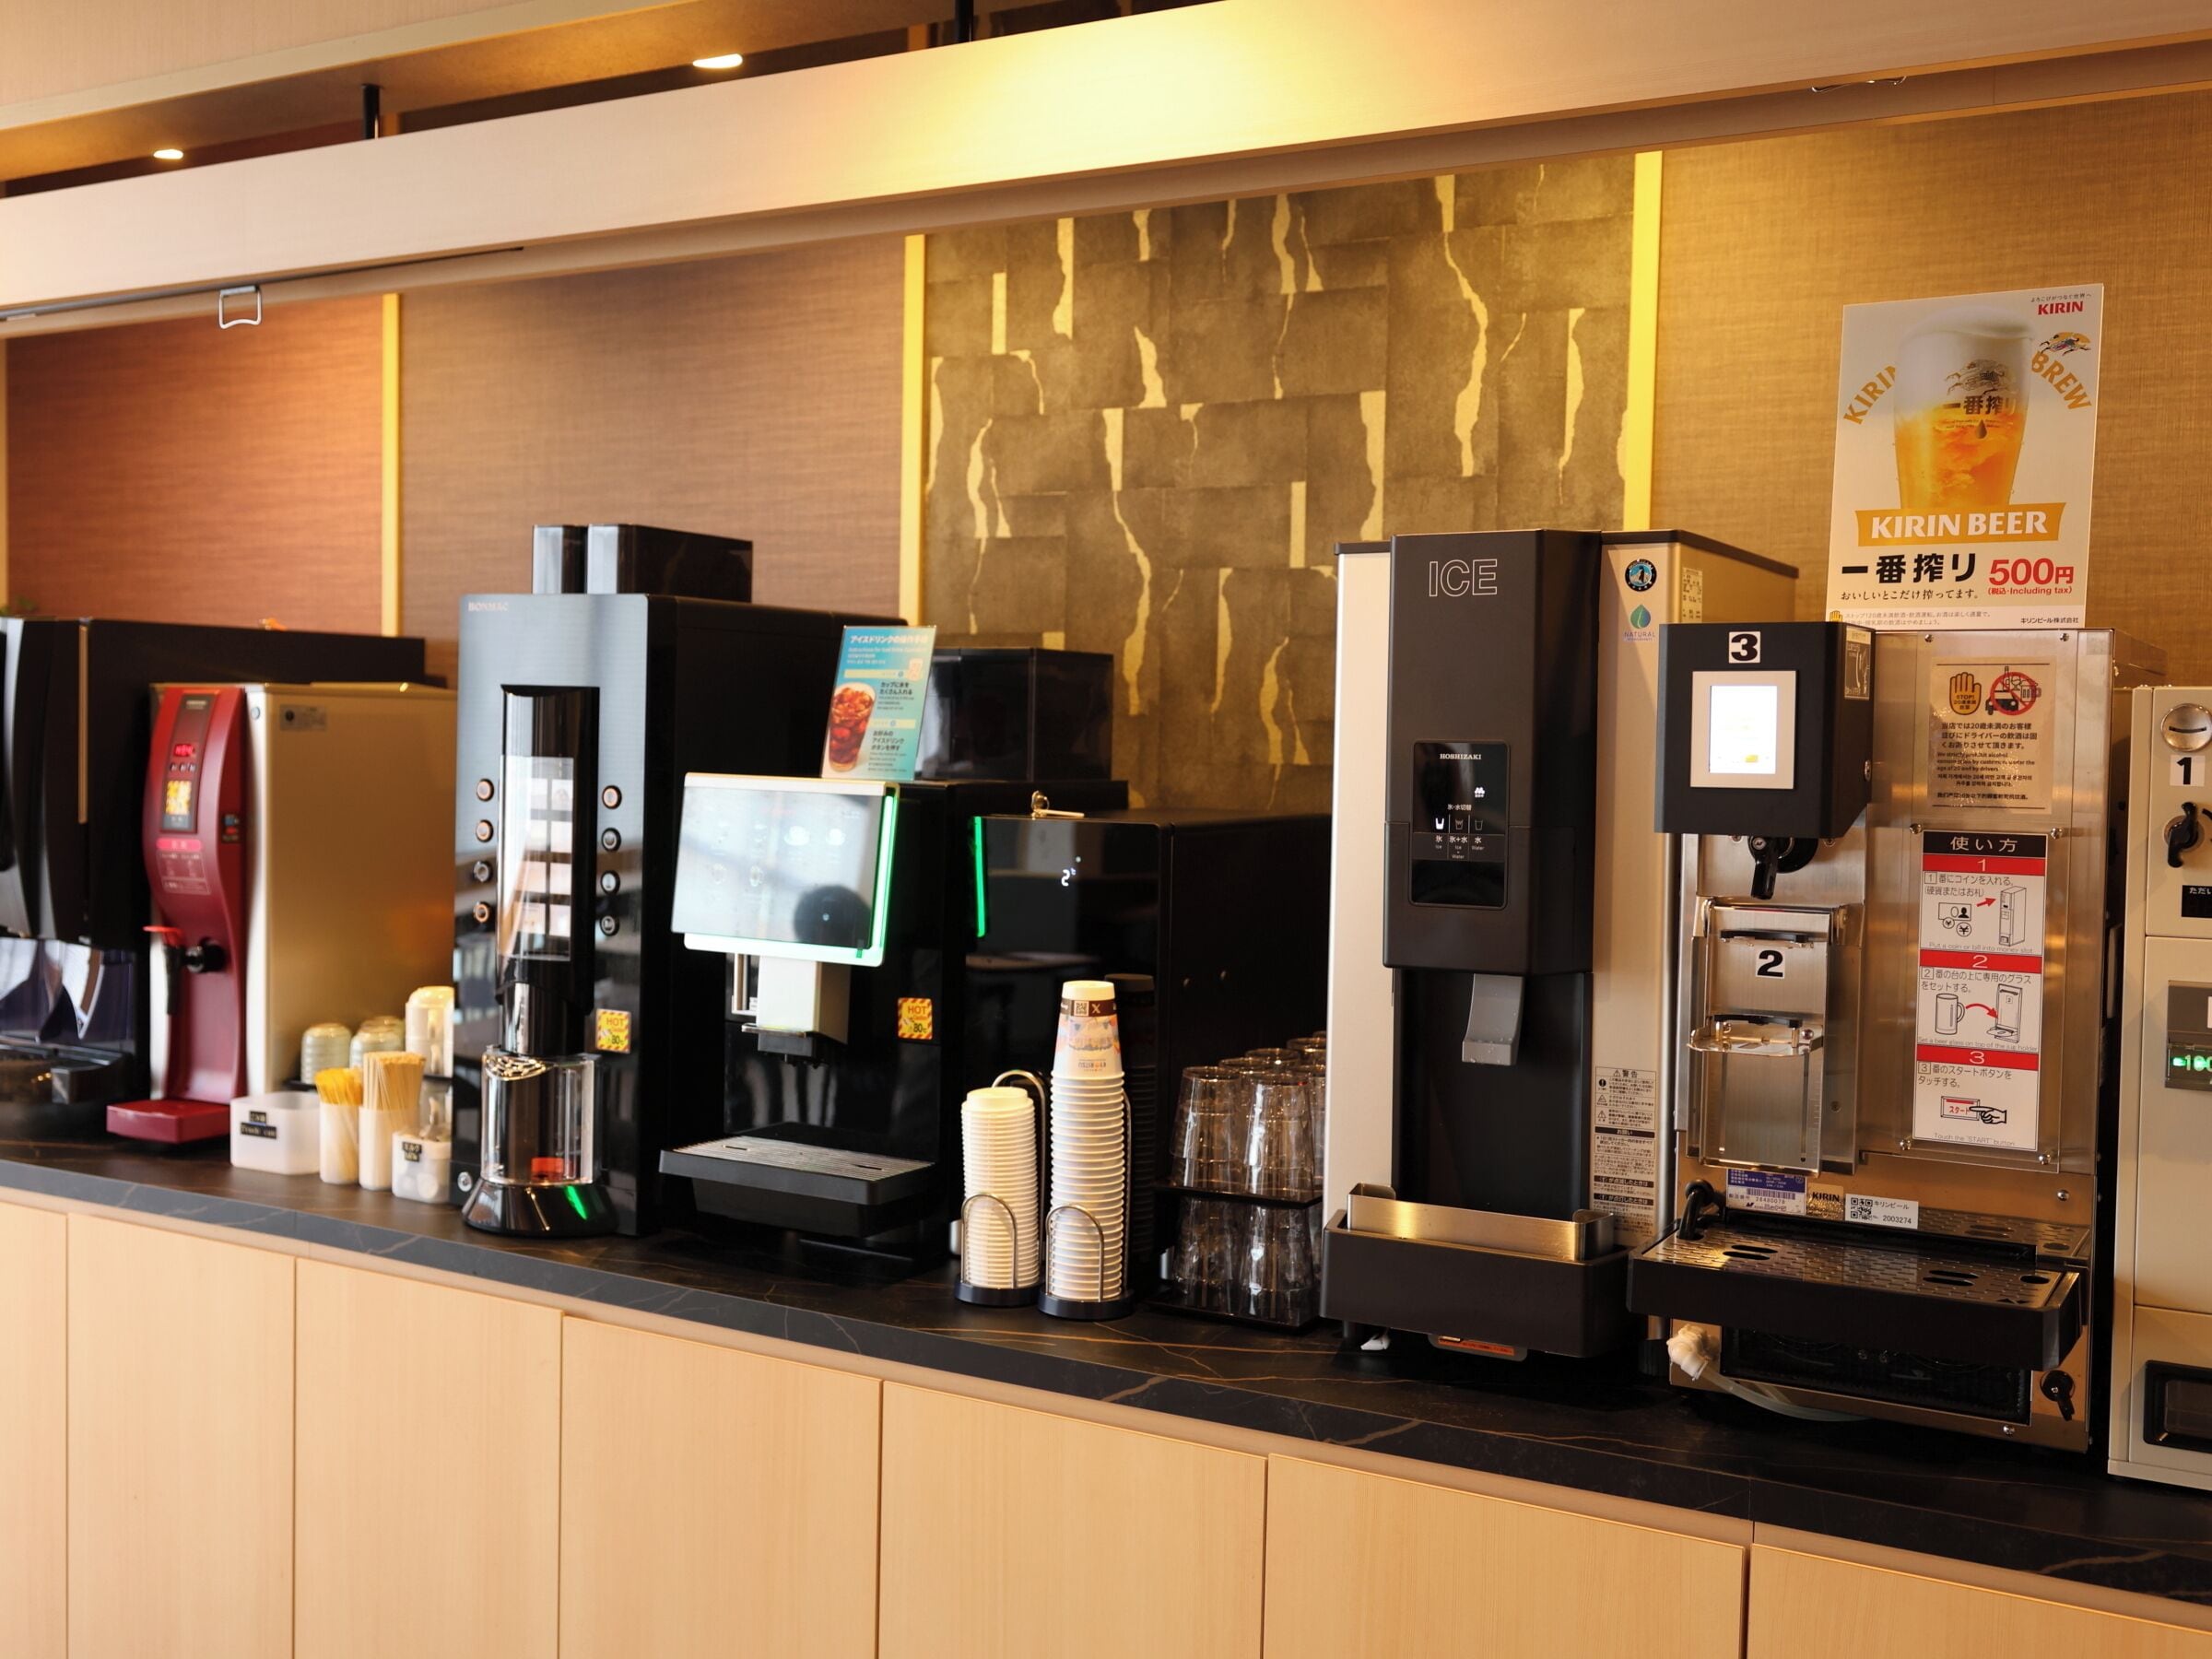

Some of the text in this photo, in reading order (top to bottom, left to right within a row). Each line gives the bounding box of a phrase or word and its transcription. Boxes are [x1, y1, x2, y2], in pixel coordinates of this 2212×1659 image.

[2038, 300, 2083, 315] KIRIN
[2031, 351, 2091, 410] BREW
[1943, 396, 2016, 416] 一番搾り
[1871, 511, 2048, 539] KIRIN BEER
[1841, 553, 1976, 583] 一番搾り
[1989, 559, 2074, 586] 500円
[1429, 559, 1498, 597] ICE
[1841, 589, 1980, 600] おいしいとこだけ搾ってます。
[1731, 633, 1759, 661] 3
[1941, 732, 2038, 740] 並びにドライバーの飲酒は固
[2176, 757, 2192, 785] 1
[1950, 836, 2018, 853] 使い方
[1977, 858, 1986, 872] 1
[1925, 886, 1984, 897] (硬貨またはお札)
[1757, 950, 1783, 977] 2
[1972, 954, 1988, 969] 2
[1921, 981, 1971, 994] をセットする。
[908, 1006, 926, 1015] HOT
[606, 1018, 624, 1026] HOT
[1969, 1051, 1985, 1065] 3
[1918, 1077, 1960, 1088] タッチする。
[1812, 1192, 1840, 1202] KIRIN
[1873, 1201, 1910, 1210] キリンビール
[1882, 1215, 1912, 1224] 2003274
